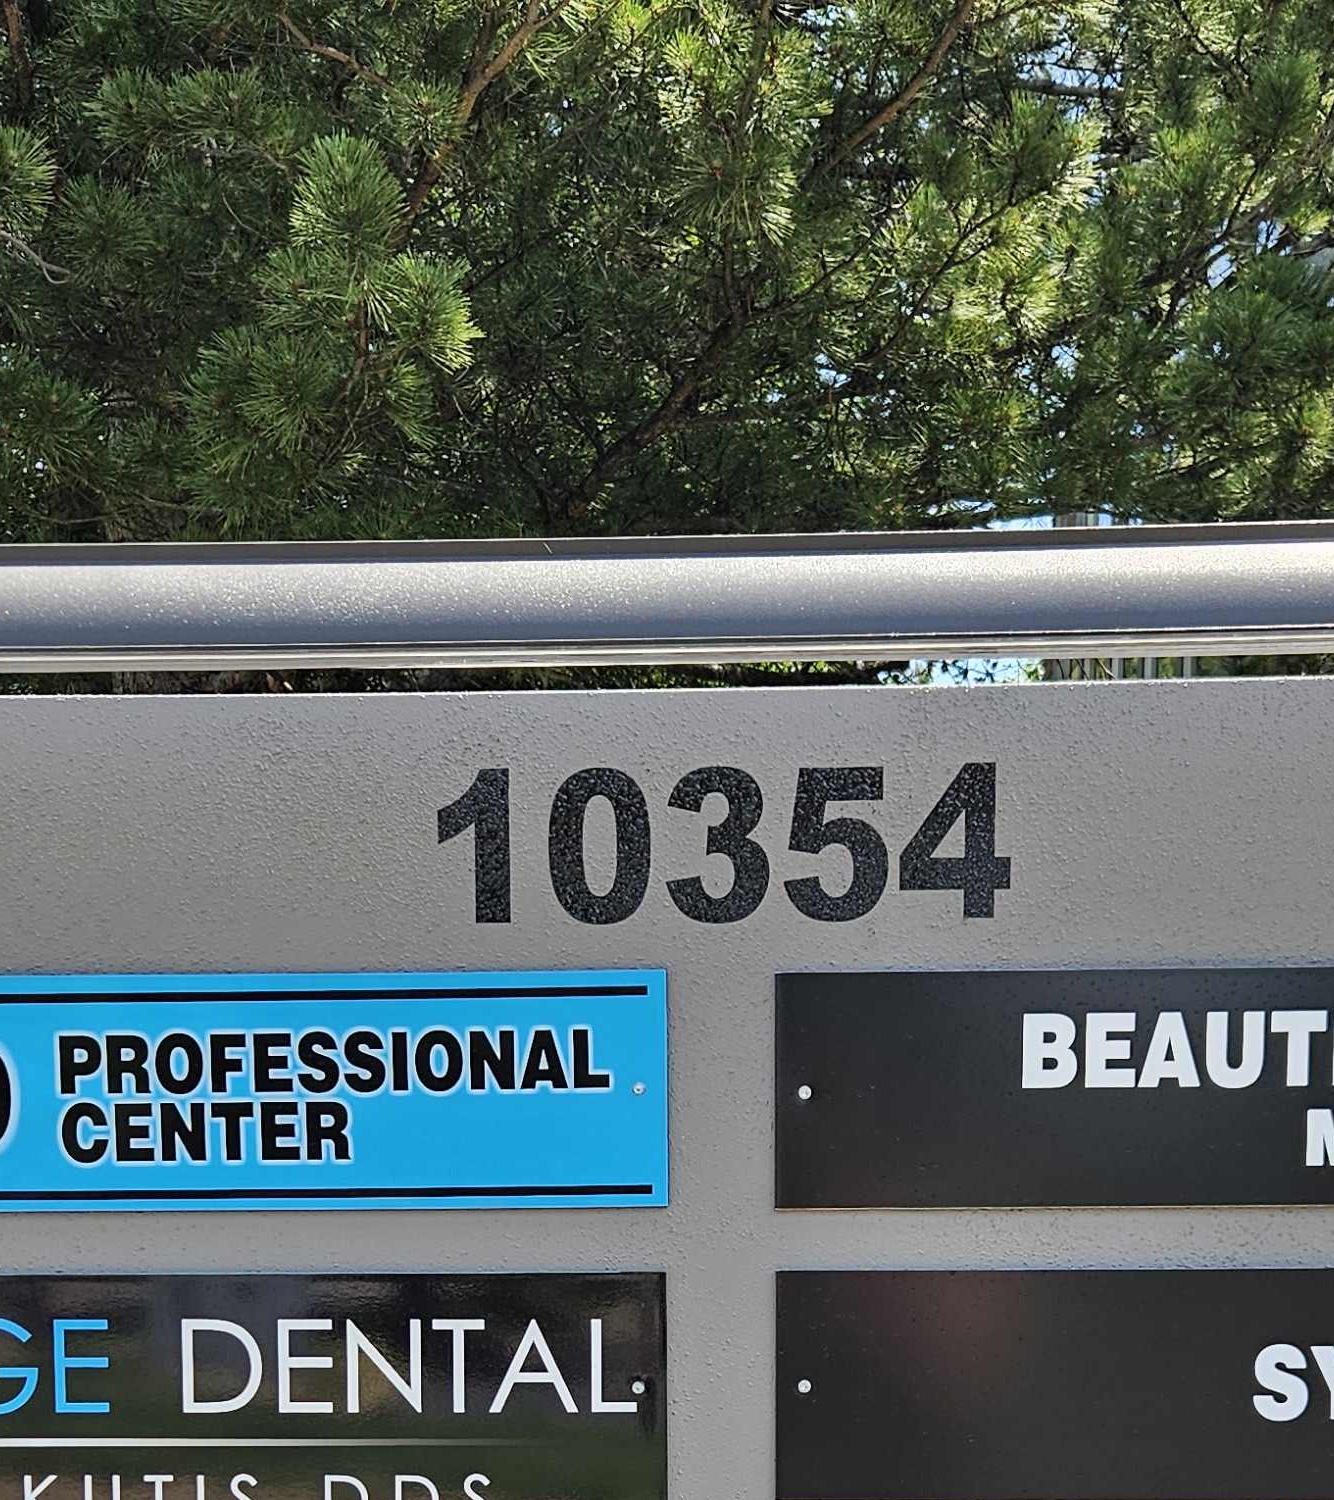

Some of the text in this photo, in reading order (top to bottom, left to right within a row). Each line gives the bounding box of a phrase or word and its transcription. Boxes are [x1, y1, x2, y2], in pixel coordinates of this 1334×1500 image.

[437, 763, 1011, 924] 10354
[59, 1030, 609, 1094] PROFESSIONAL
[62, 1101, 351, 1164] CENTER
[182, 1319, 641, 1413] DENTAL
